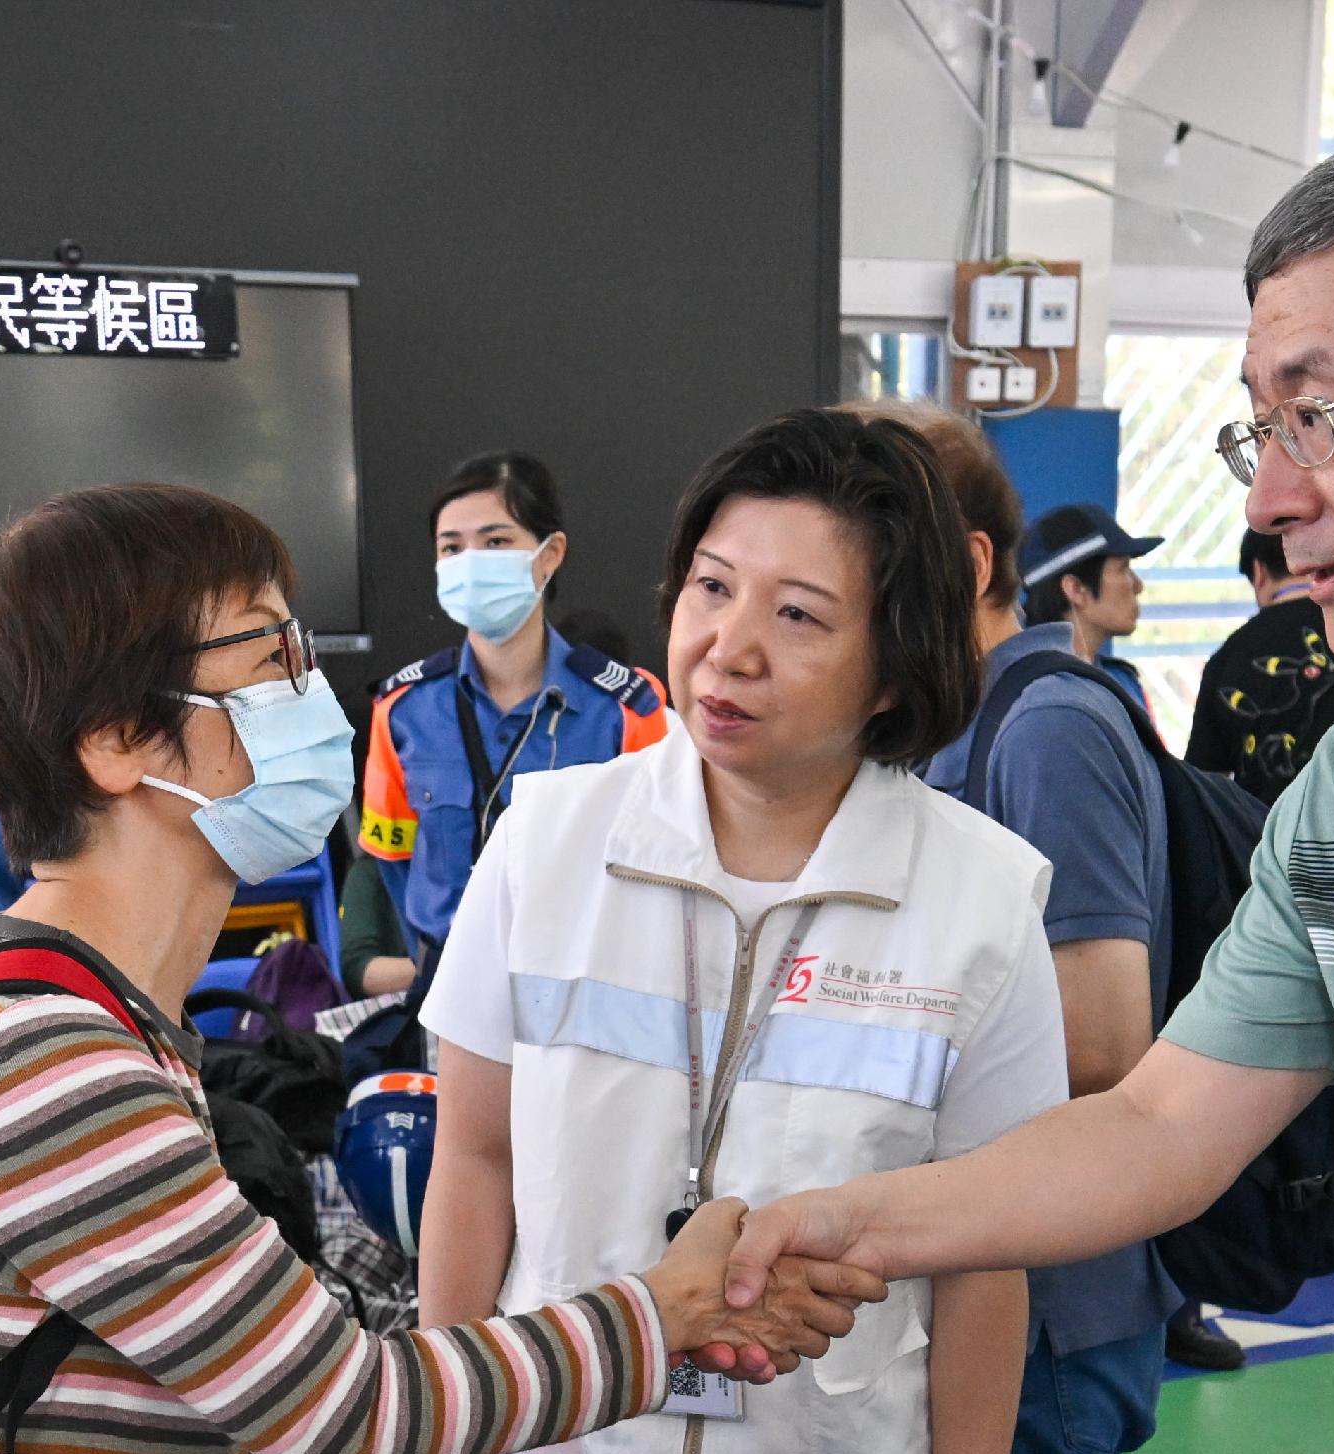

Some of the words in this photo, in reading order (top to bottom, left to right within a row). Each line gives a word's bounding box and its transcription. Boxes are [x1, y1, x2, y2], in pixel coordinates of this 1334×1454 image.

[363, 816, 403, 846] AS
[824, 962, 903, 984] 社會福利署
[818, 982, 857, 1000] Social
[861, 988, 903, 1004] Welfare
